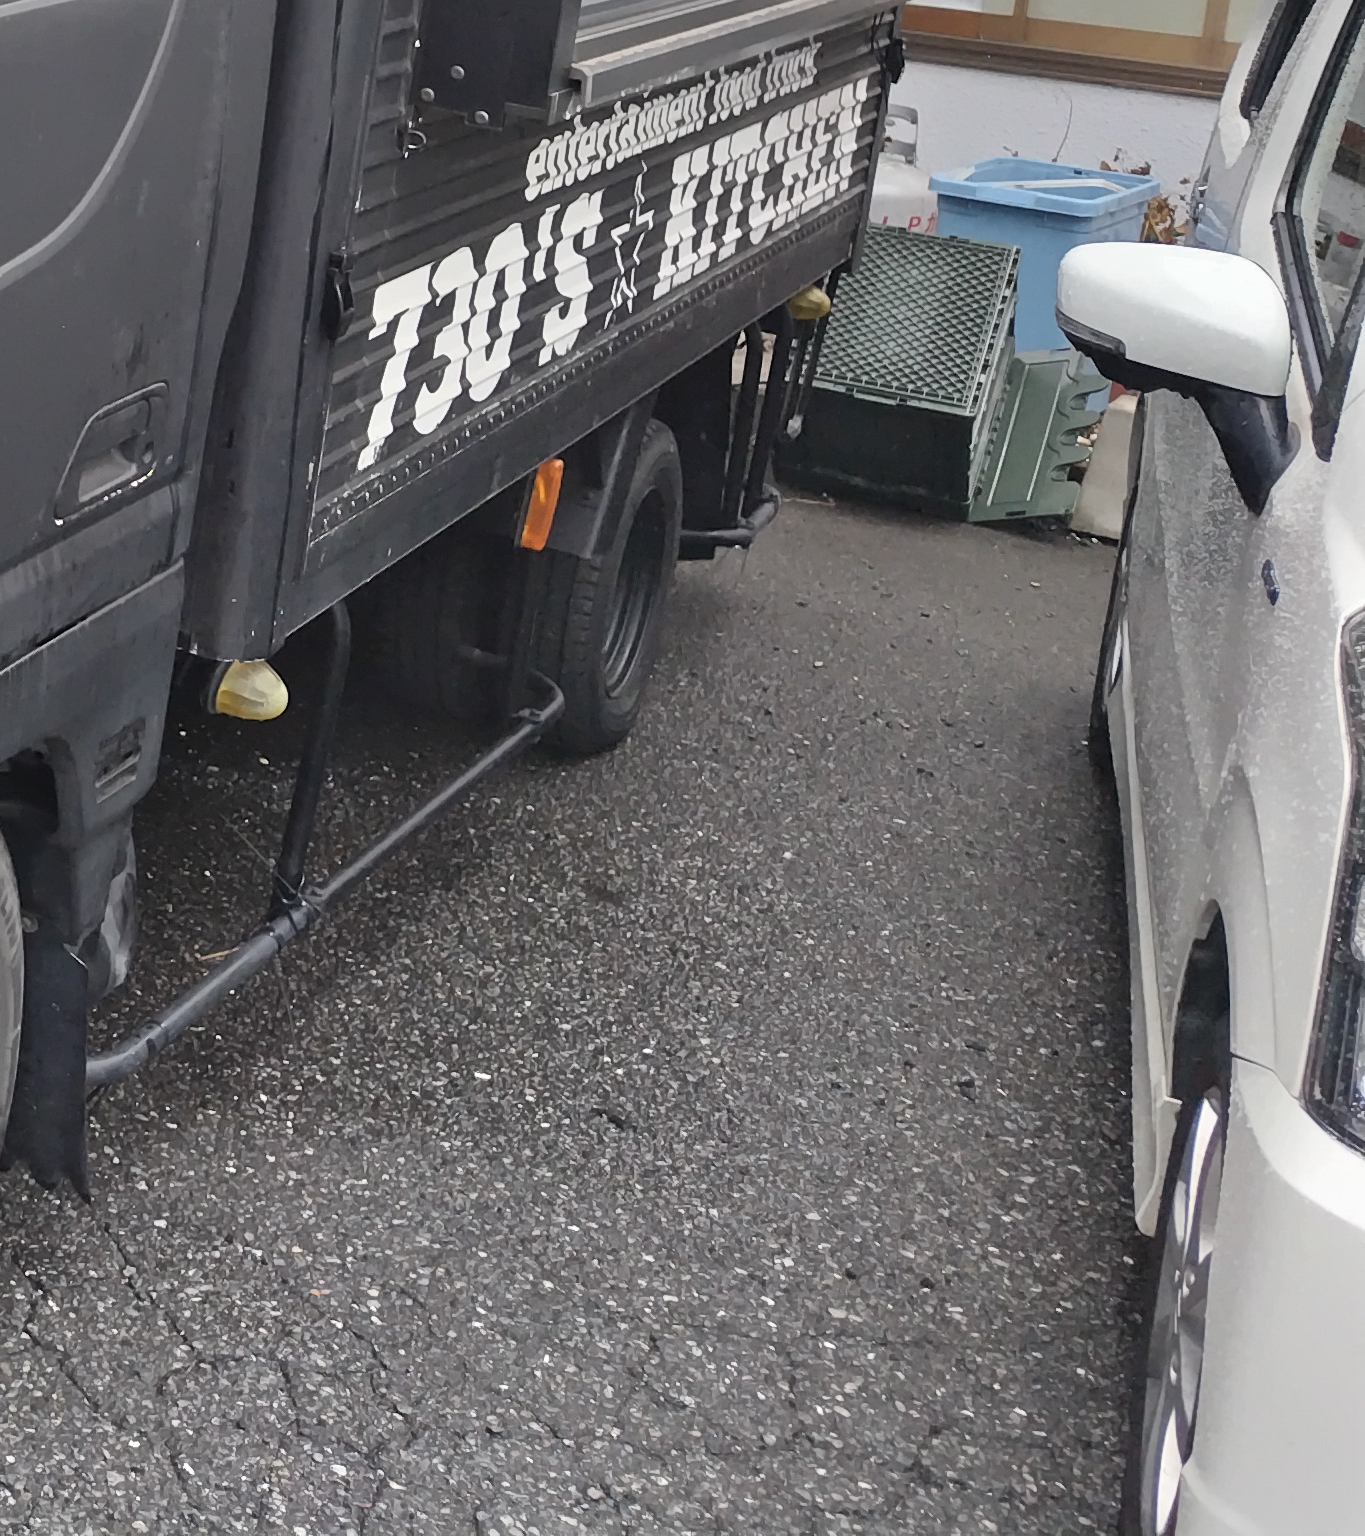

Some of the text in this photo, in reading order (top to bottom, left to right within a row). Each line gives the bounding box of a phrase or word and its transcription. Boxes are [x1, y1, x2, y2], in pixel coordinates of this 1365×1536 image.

[709, 52, 766, 124] food
[764, 35, 823, 104] truck
[357, 77, 869, 471] 730'S KITCHEN
